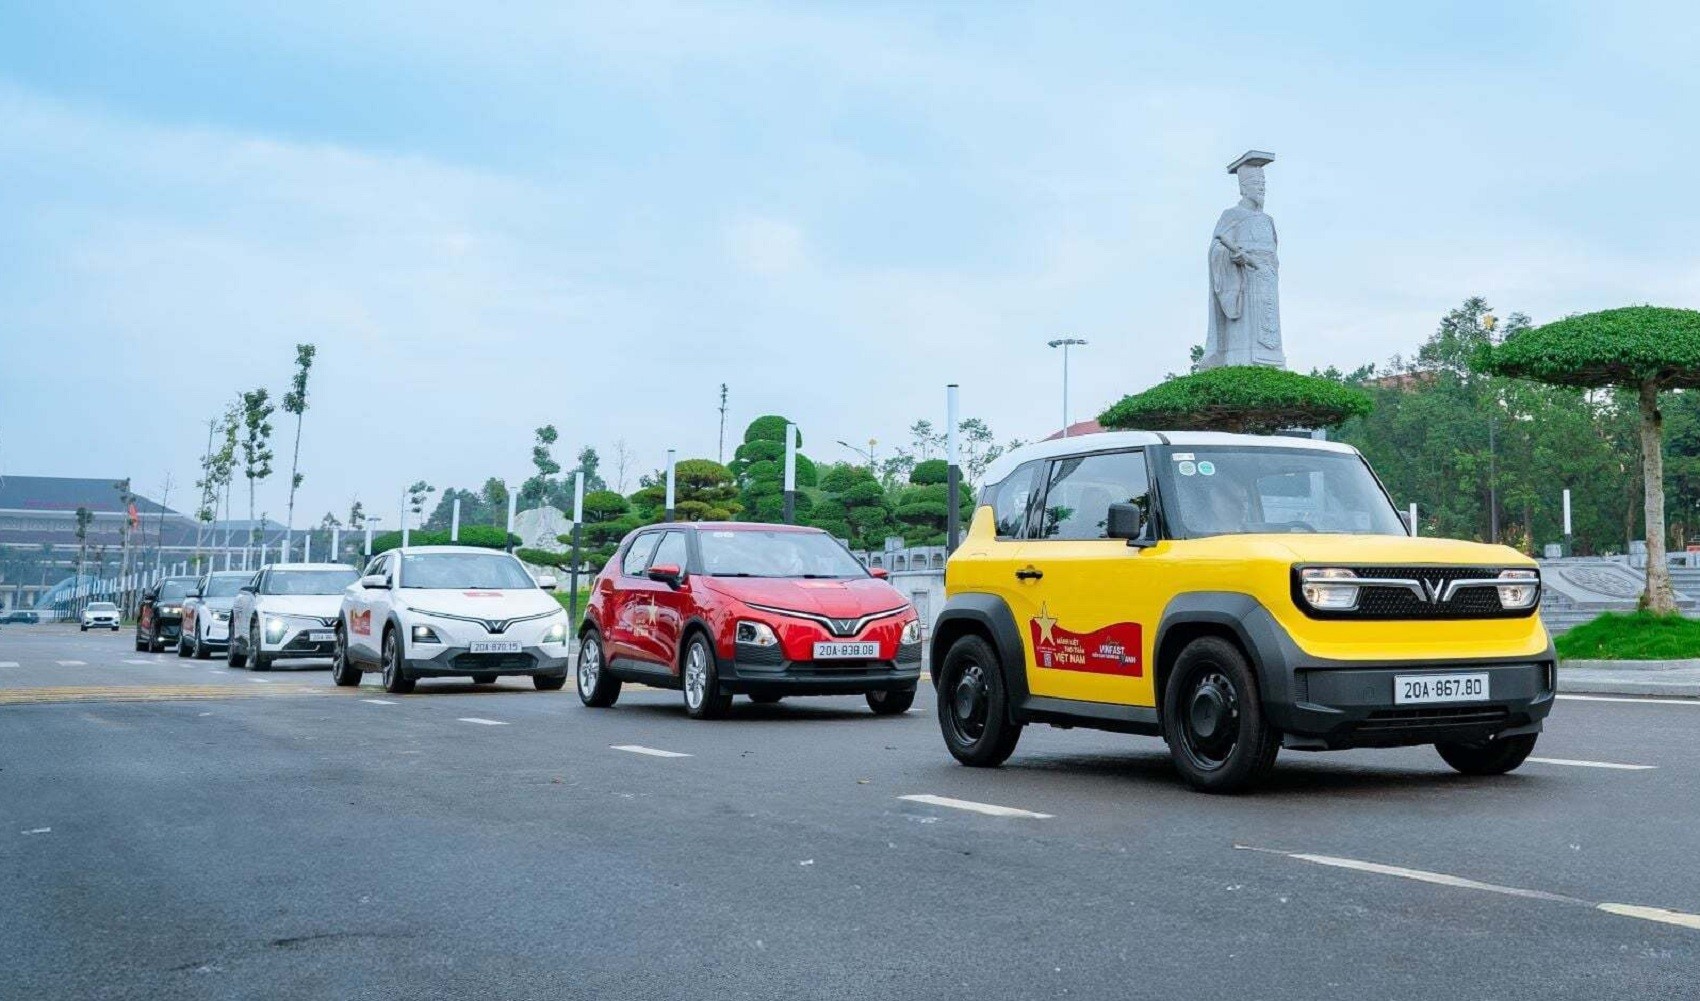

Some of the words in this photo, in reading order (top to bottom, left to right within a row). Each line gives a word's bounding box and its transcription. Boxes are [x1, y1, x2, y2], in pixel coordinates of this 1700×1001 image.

[1054, 652, 1068, 664] VIỆT
[1070, 654, 1086, 664] NAM
[1404, 679, 1482, 699] 20A-867.80
